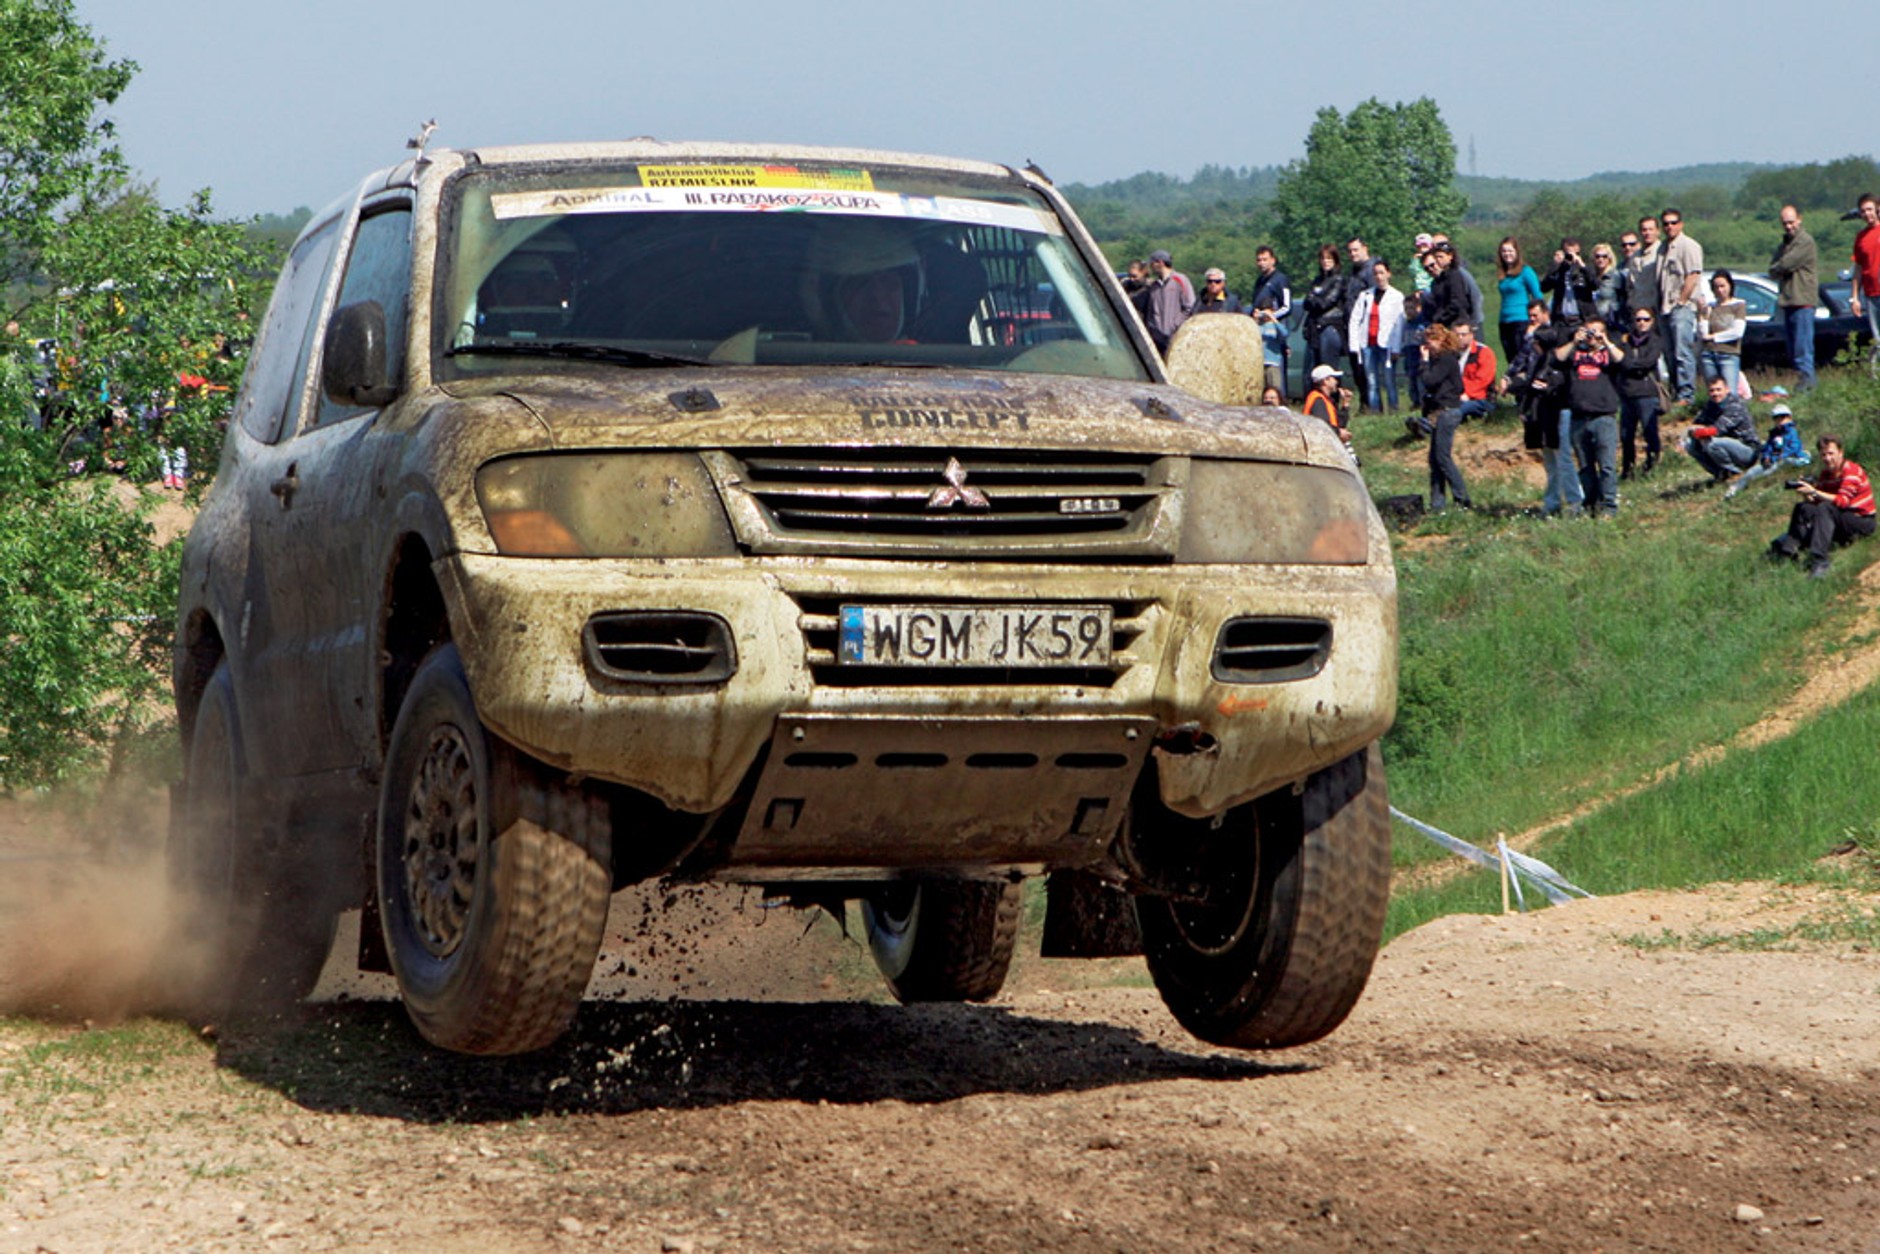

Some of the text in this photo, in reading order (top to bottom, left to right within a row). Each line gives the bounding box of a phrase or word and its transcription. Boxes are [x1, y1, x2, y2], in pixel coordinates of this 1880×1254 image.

[819, 195, 881, 209] KUPA
[873, 613, 1103, 660] WGM JK59
